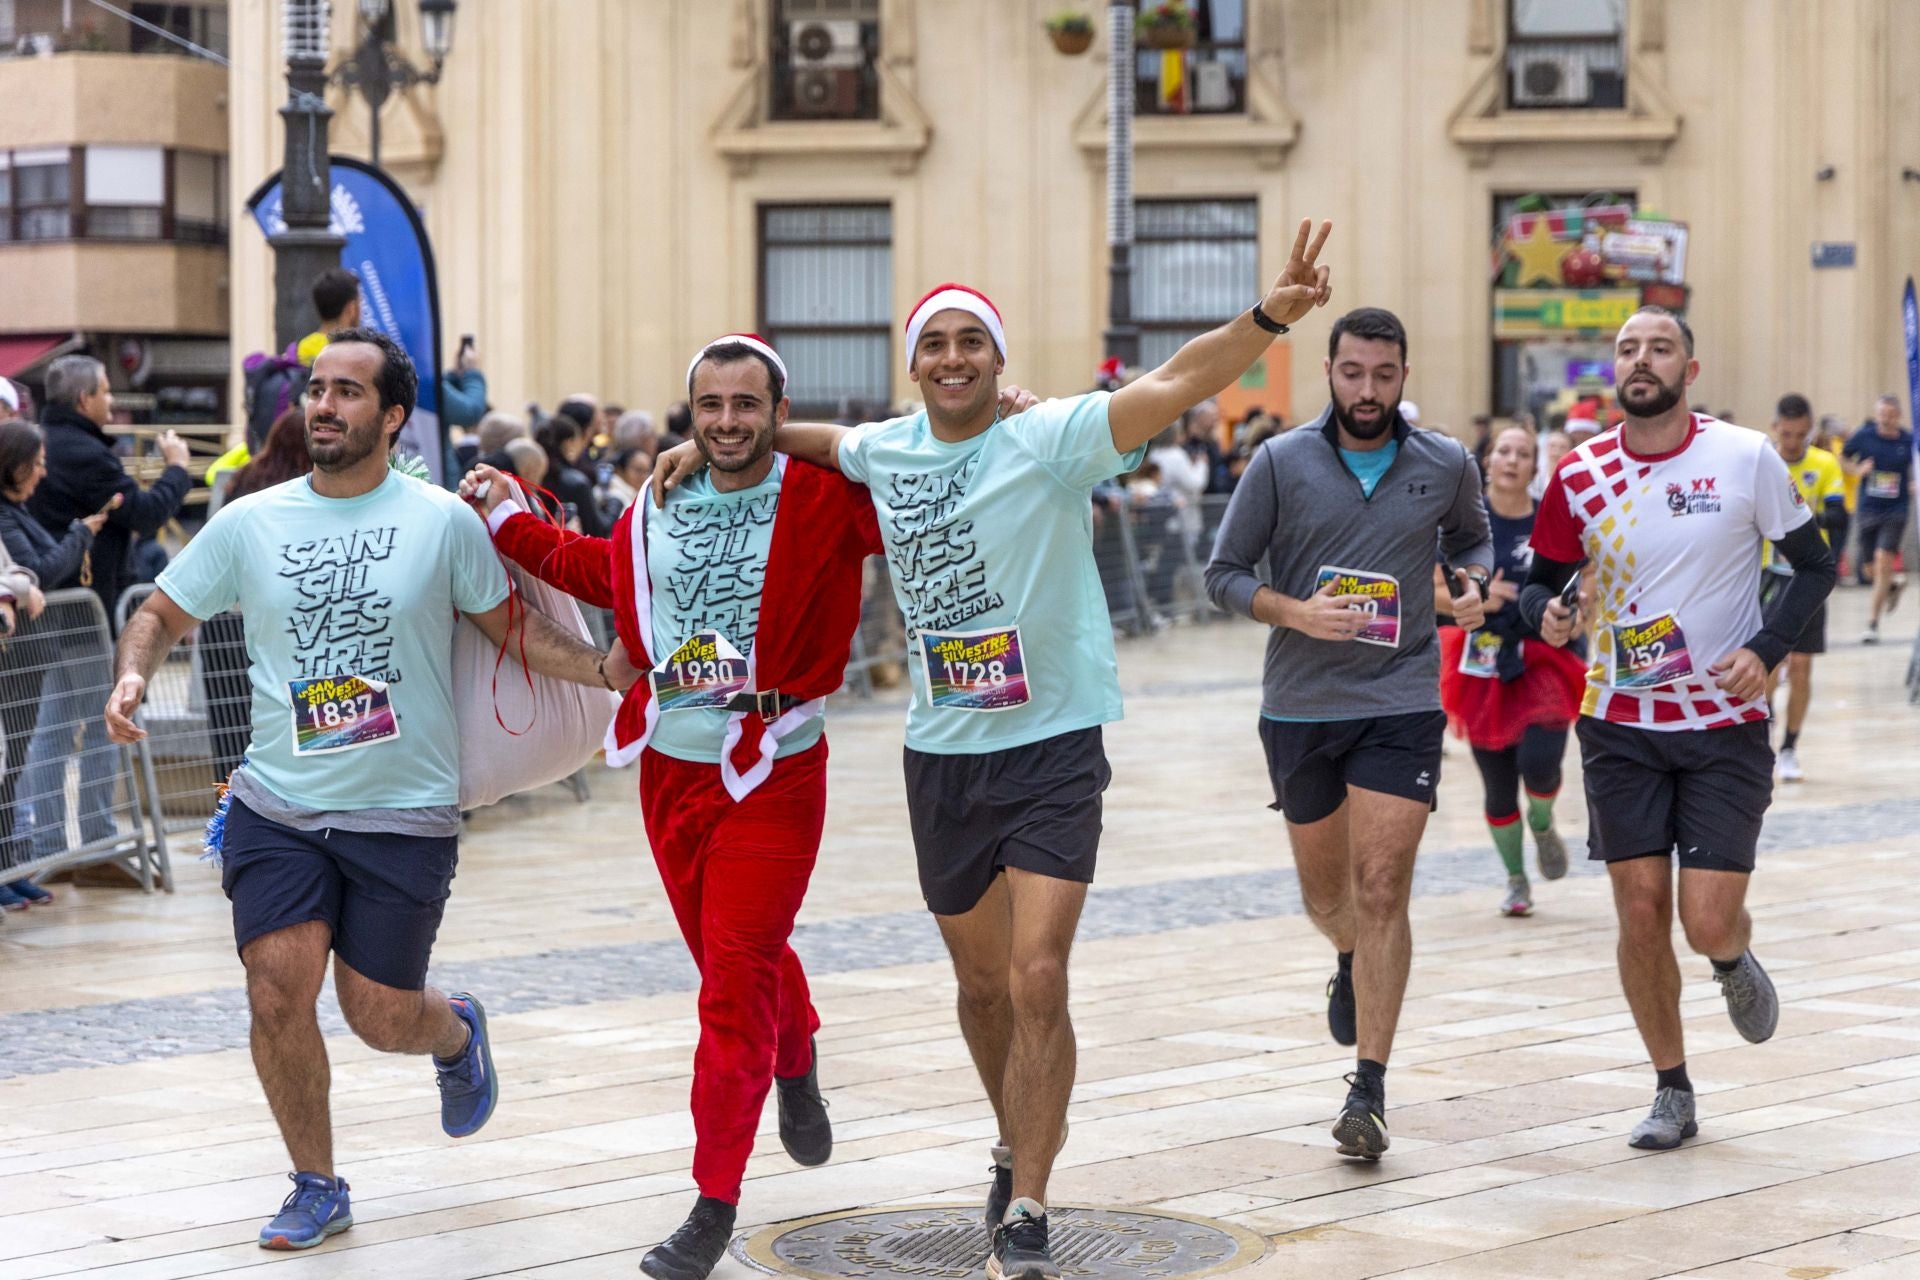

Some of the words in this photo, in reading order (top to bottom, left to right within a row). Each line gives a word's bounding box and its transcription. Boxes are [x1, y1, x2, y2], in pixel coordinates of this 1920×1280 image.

[887, 459, 979, 510] SAN
[668, 492, 780, 538] SAN
[890, 501, 959, 546] SIL
[278, 527, 399, 578] SAN
[674, 529, 758, 574] SIL
[890, 519, 976, 582] VES
[294, 564, 378, 612] SIL
[665, 561, 768, 611] VES
[902, 561, 987, 620] TRE
[285, 597, 392, 650] VES
[672, 604, 760, 649] TRE
[941, 639, 963, 653] SAN
[293, 637, 394, 679] TRE
[943, 633, 1009, 663] SILVESTRE
[968, 644, 1010, 664] CARTAGENA
[1627, 641, 1666, 669] 252
[307, 680, 334, 697] SAN
[672, 660, 734, 687] 1930
[943, 660, 1007, 687] 1728
[308, 693, 373, 729] 1837
